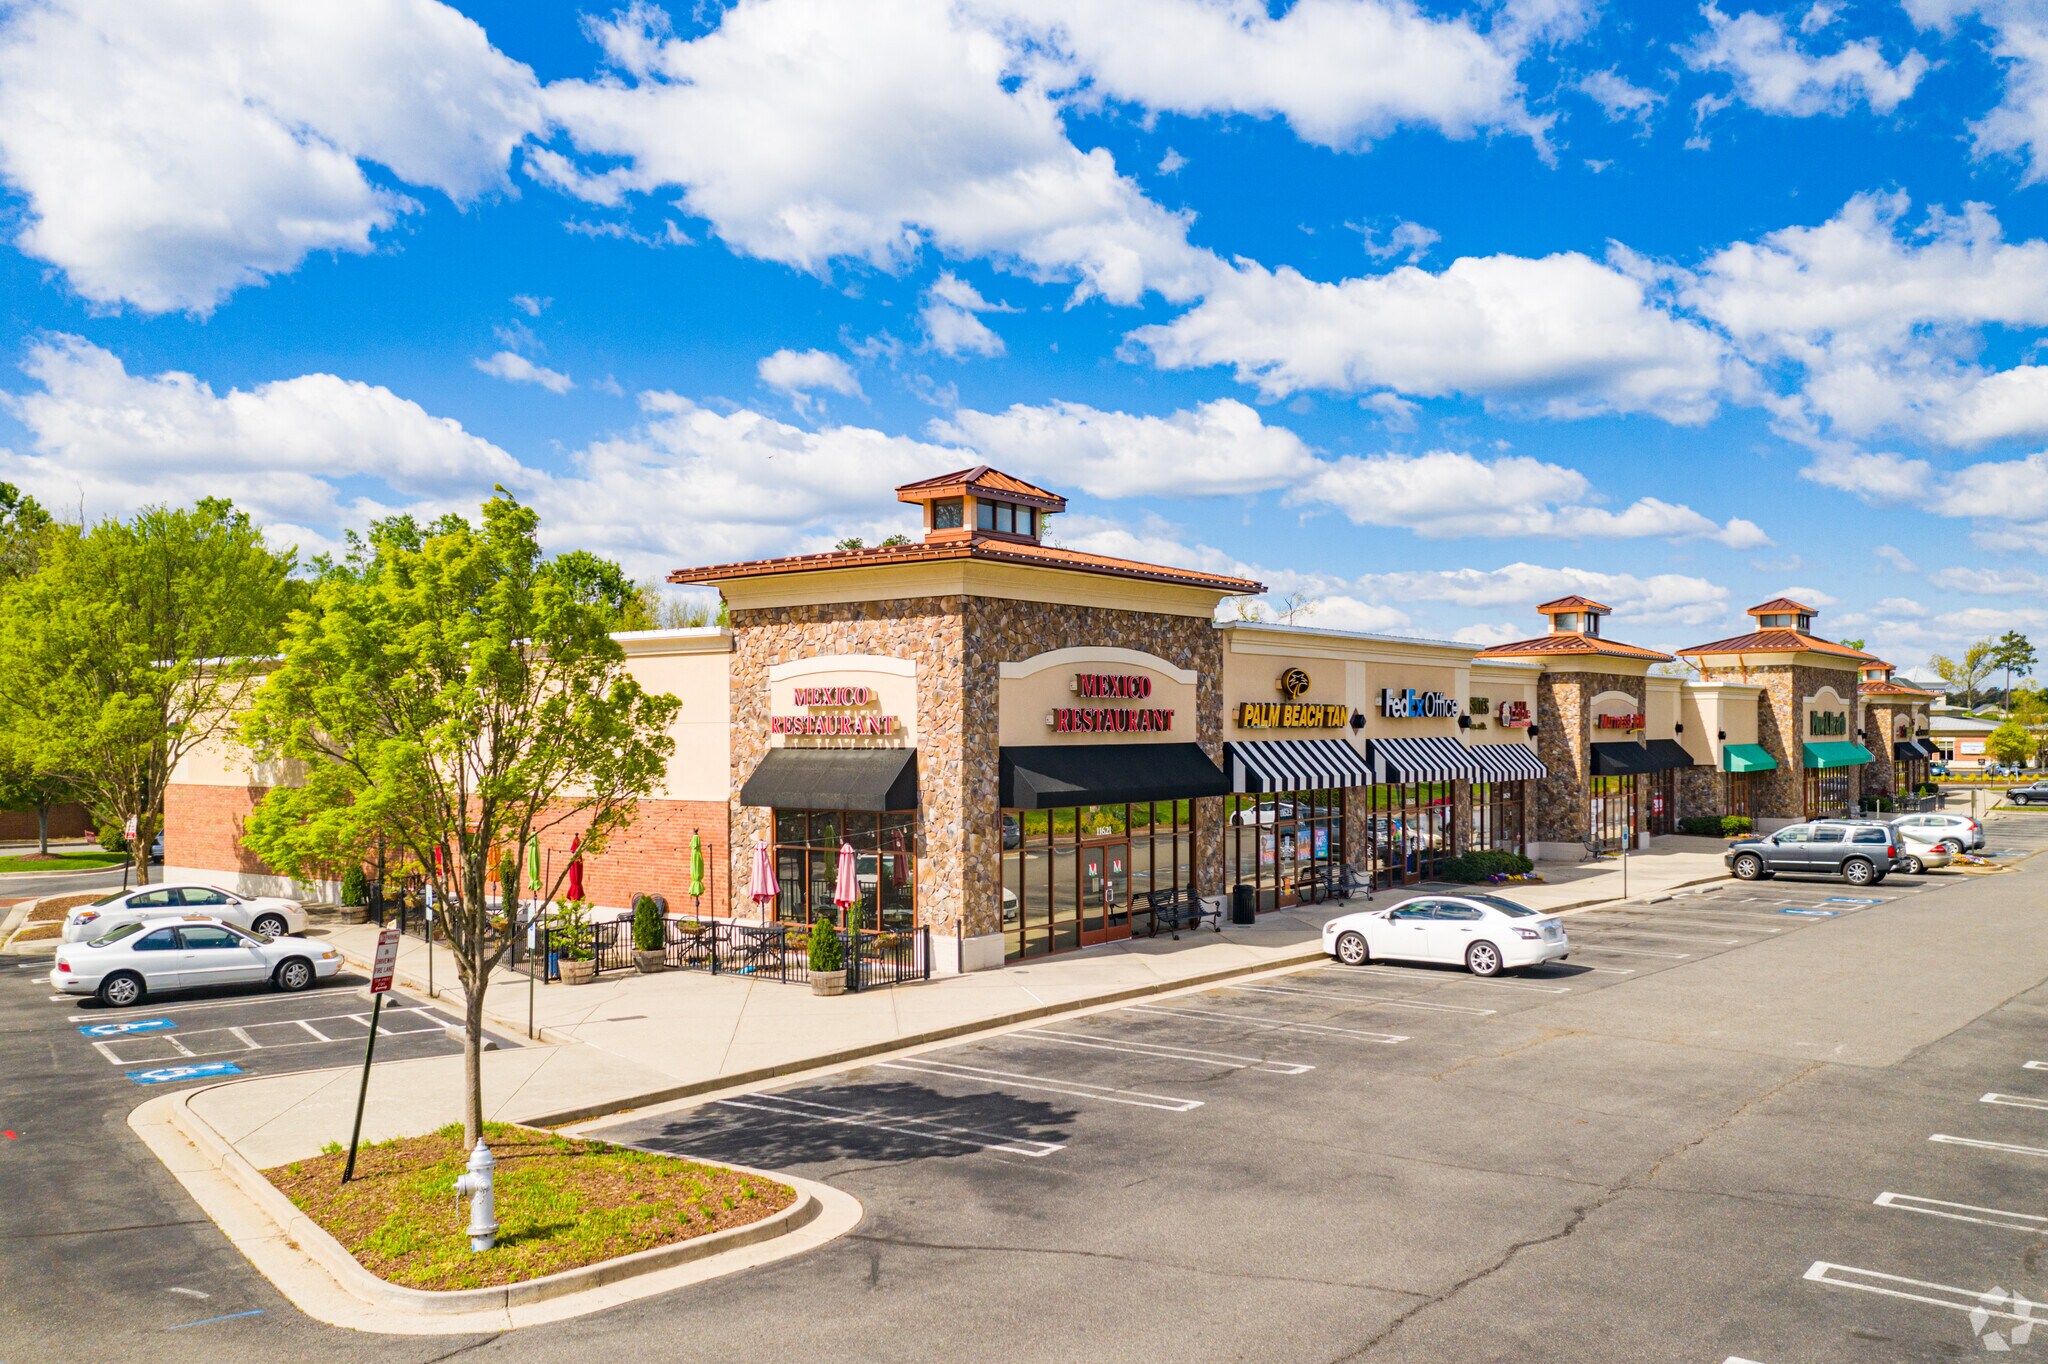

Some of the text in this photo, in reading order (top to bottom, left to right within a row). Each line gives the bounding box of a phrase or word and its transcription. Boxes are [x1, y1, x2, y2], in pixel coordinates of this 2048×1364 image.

[793, 686, 869, 706] MEXICO
[1078, 674, 1152, 699] MEXICO
[1384, 688, 1459, 718] FedEx Office
[771, 715, 894, 736] RESTAURANT
[1056, 708, 1174, 733] RESTAURANT
[1243, 704, 1350, 727] PALM BEACH TAN
[1096, 825, 1112, 836] 11621
